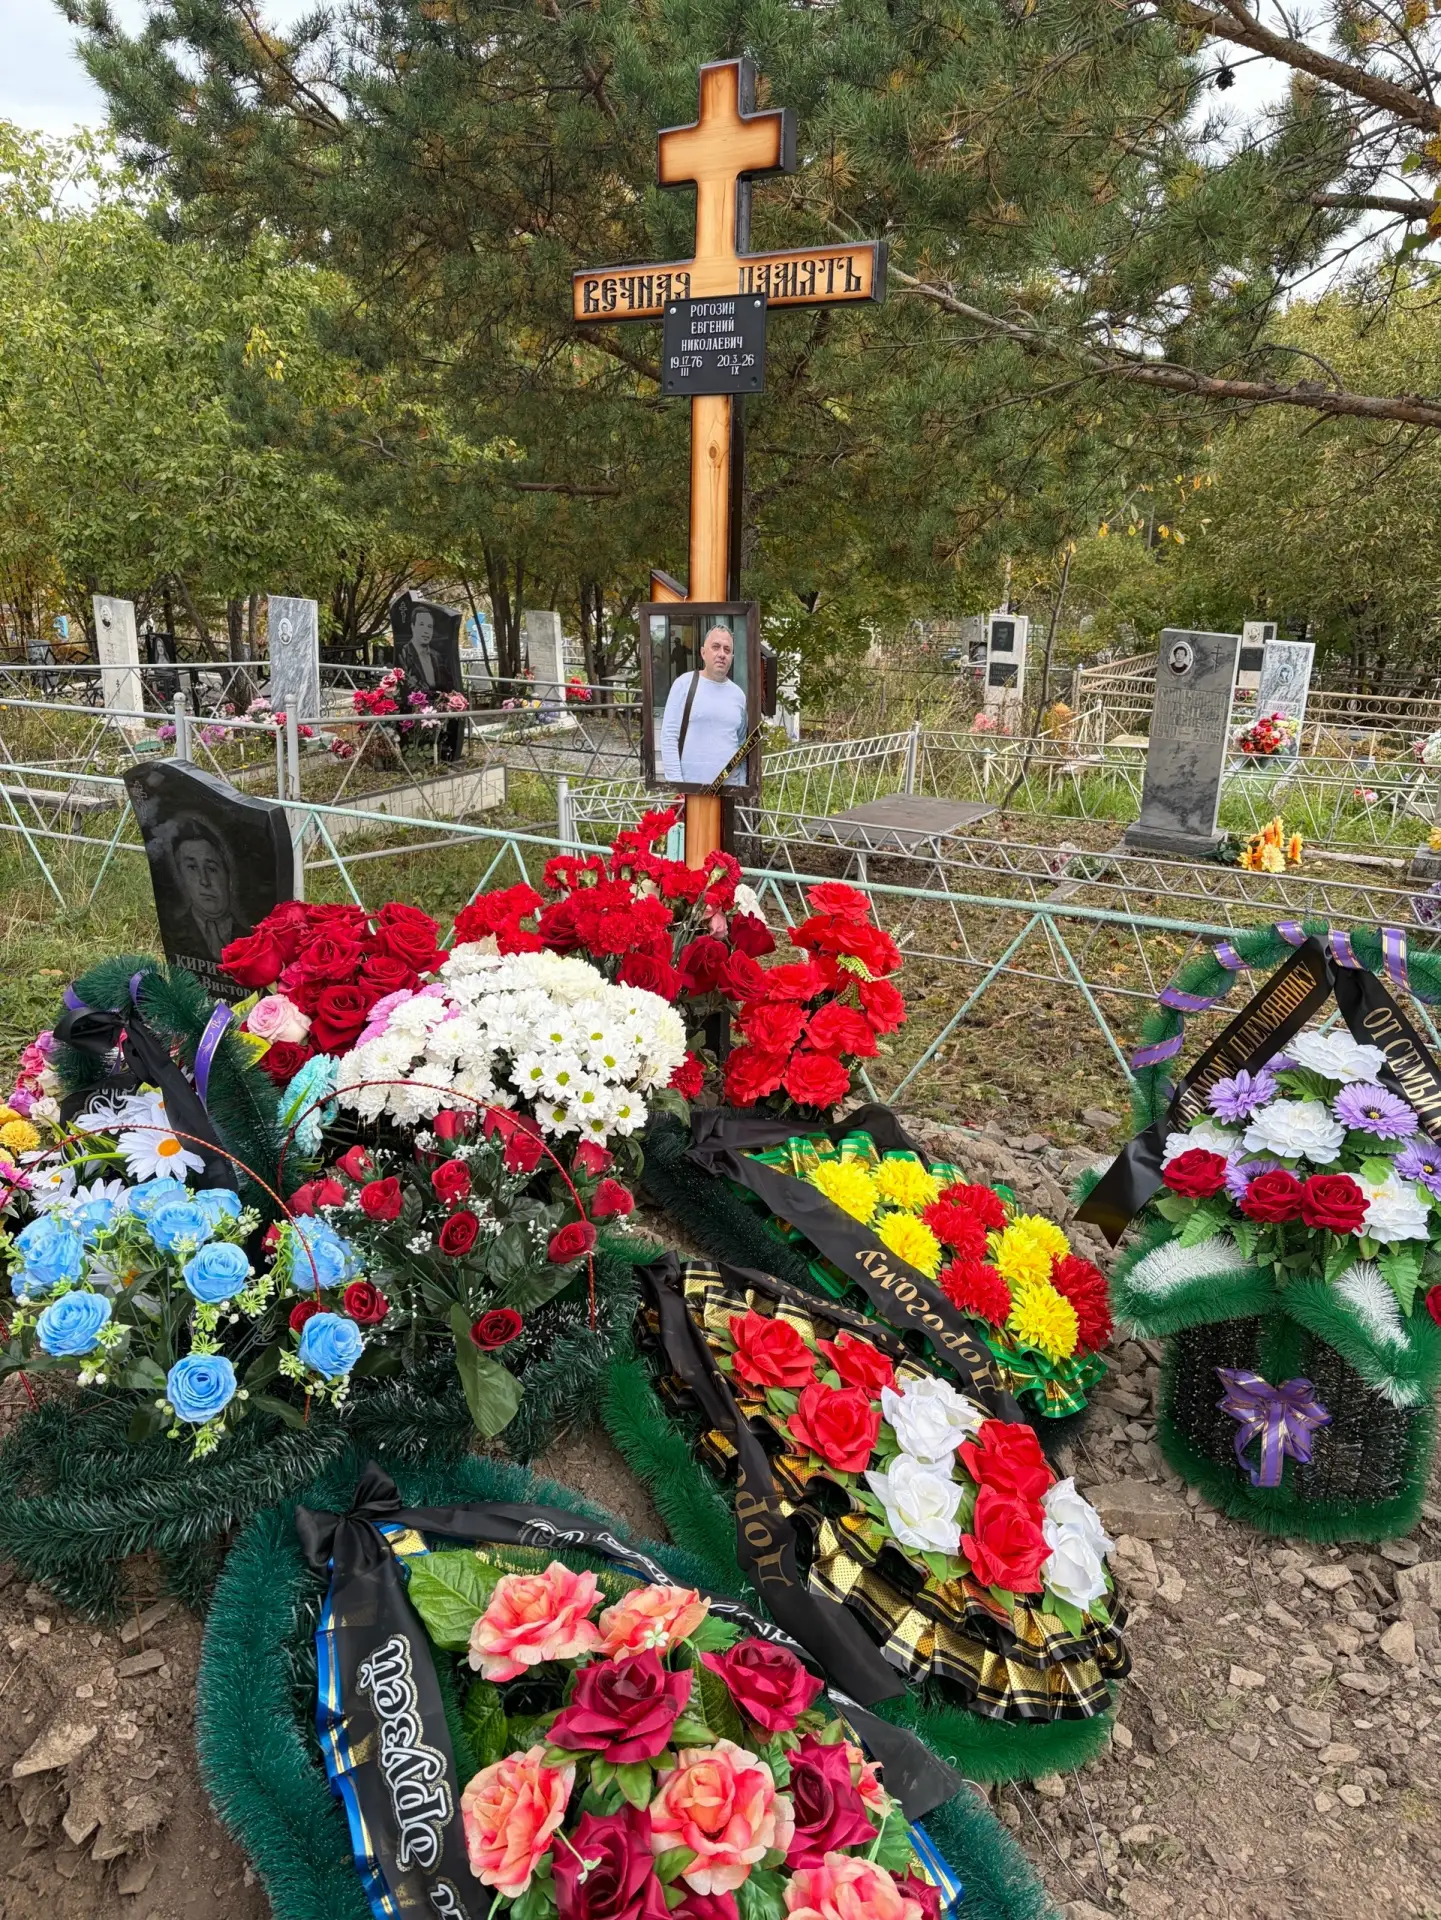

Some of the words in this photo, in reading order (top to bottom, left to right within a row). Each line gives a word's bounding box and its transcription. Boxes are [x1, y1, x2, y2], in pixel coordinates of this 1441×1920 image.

[681, 336, 743, 352] НИКОЛАЕВИЧ
[690, 302, 735, 317] РОГОЗИН
[691, 317, 735, 334] ЕВГЕНИЙ
[1227, 960, 1317, 1061] ПЛЕМЯННИКУ
[1362, 1007, 1402, 1041] ОТ
[1383, 1038, 1441, 1115] СЕМЬИ
[855, 1249, 1004, 1393] Дорогому
[359, 1637, 449, 1869] друзей
